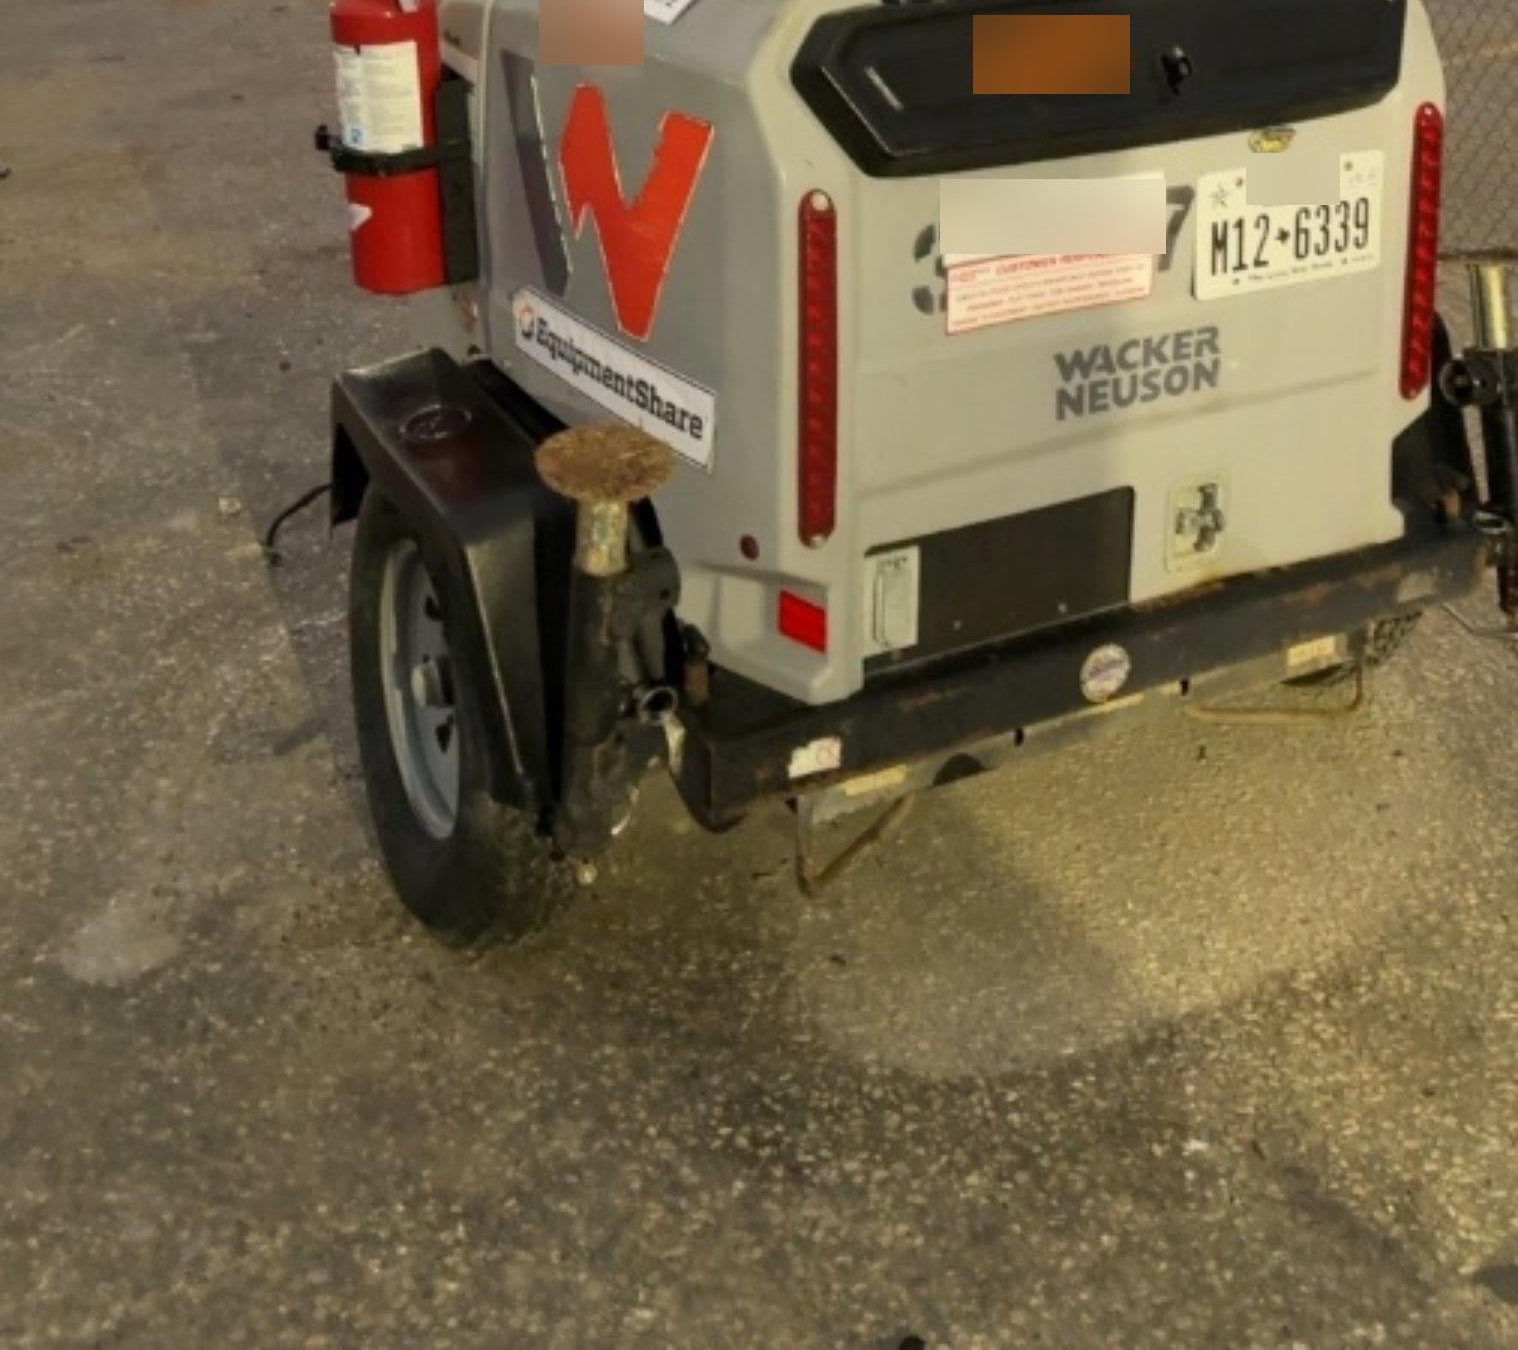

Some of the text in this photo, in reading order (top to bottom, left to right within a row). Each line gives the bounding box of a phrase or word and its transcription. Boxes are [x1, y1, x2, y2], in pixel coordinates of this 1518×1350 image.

[535, 317, 705, 440] EquipmentShare
[1054, 326, 1221, 382] WACKER
[1055, 357, 1221, 421] NEUSON
